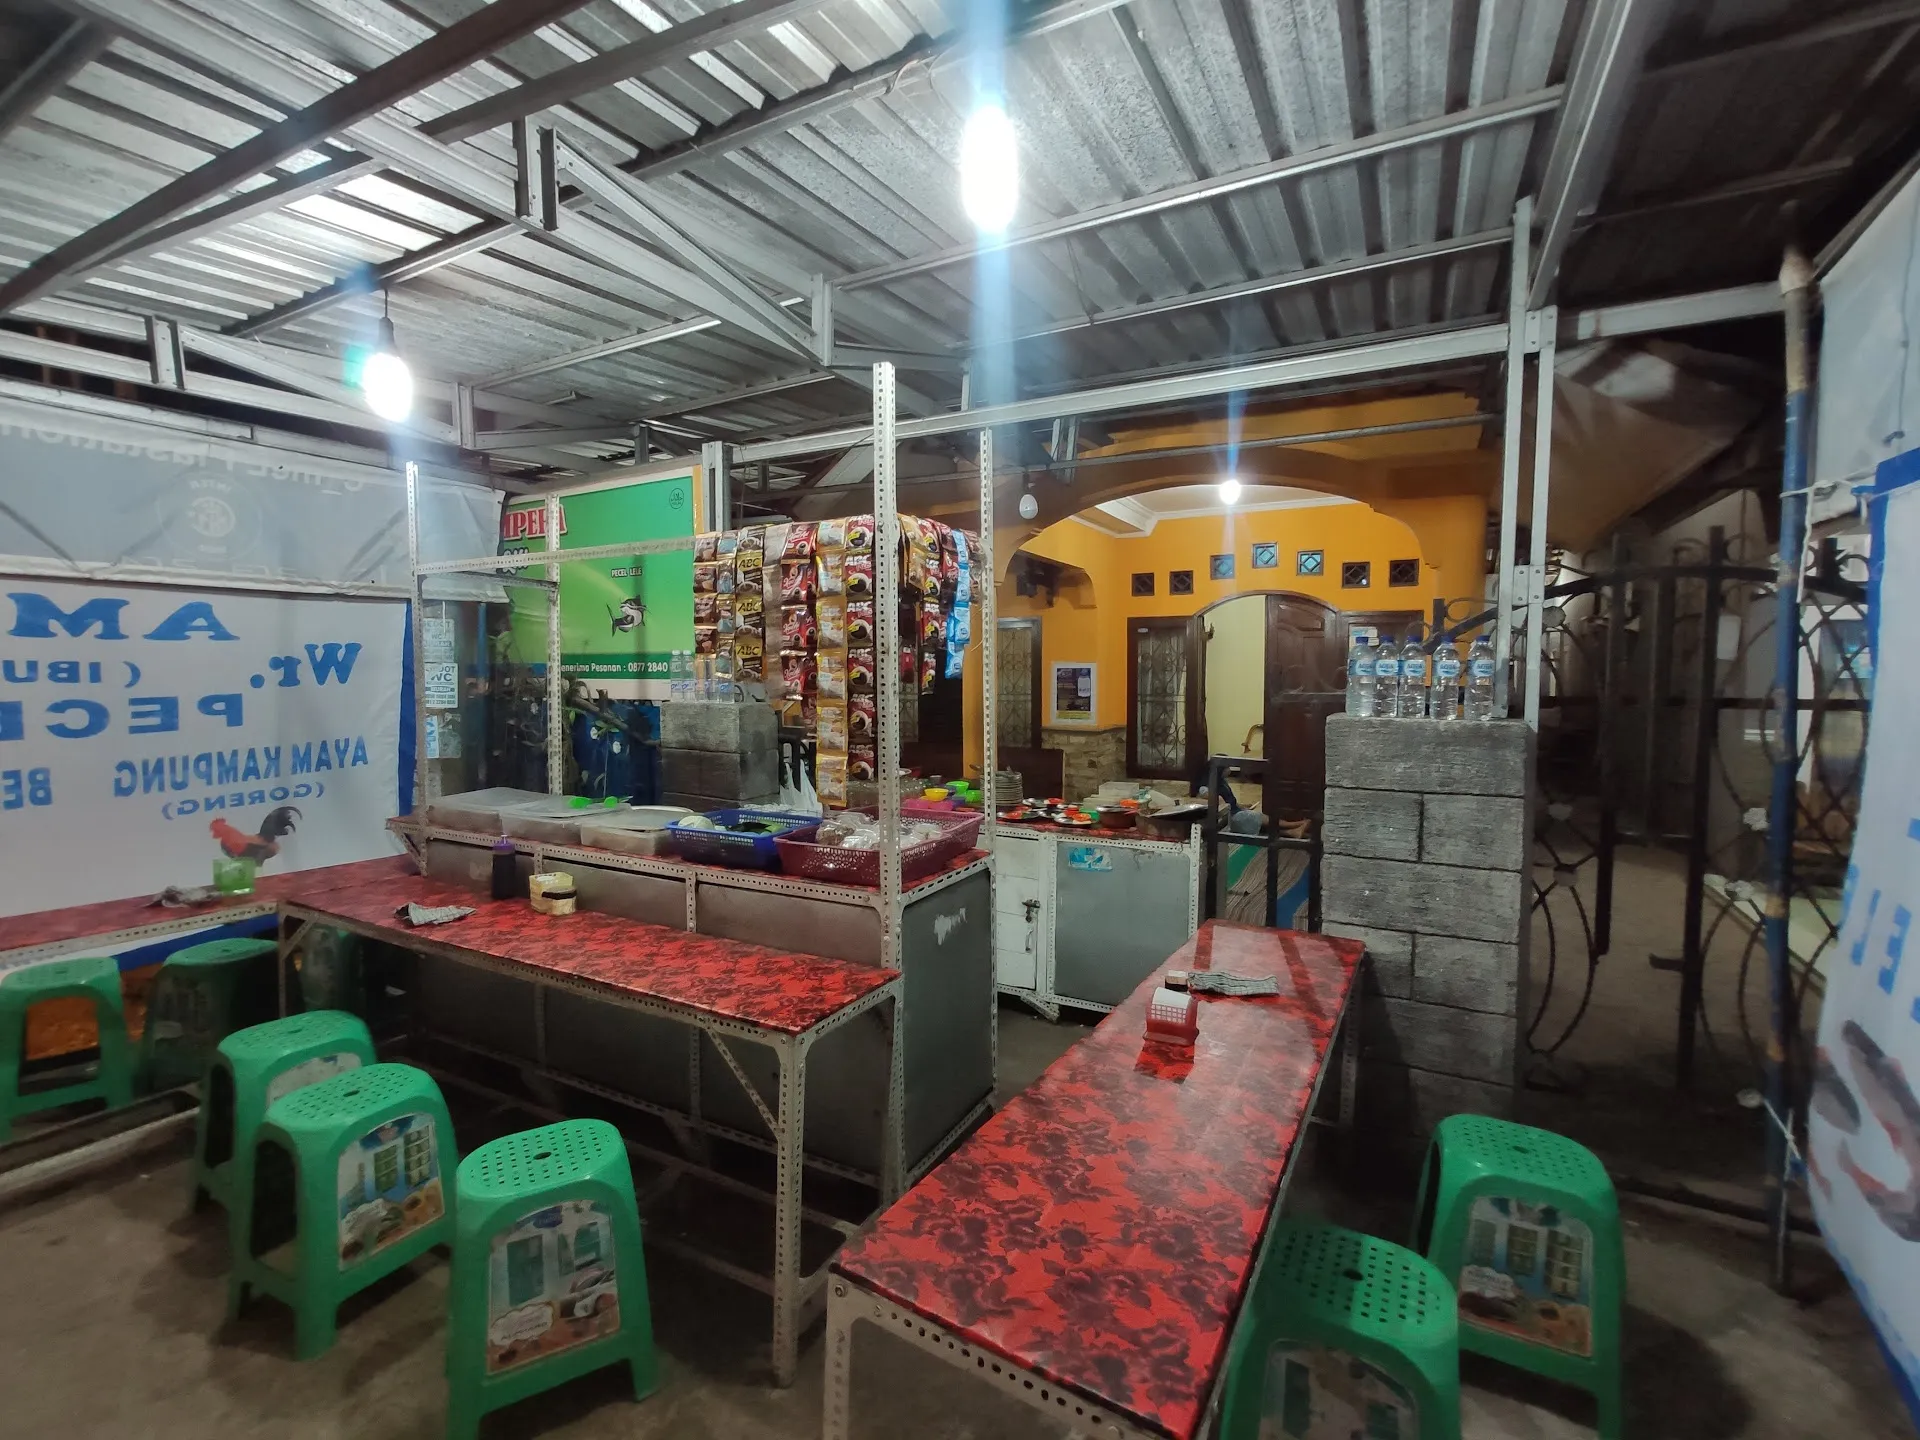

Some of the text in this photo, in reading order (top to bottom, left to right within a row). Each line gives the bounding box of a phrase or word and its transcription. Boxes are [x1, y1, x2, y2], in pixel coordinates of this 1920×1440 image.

[739, 558, 760, 568] ABC
[738, 603, 759, 613] ABC
[737, 646, 760, 656] ABC
[591, 663, 622, 672] Pesanan
[628, 662, 645, 672] 0877
[647, 662, 668, 672] 2840
